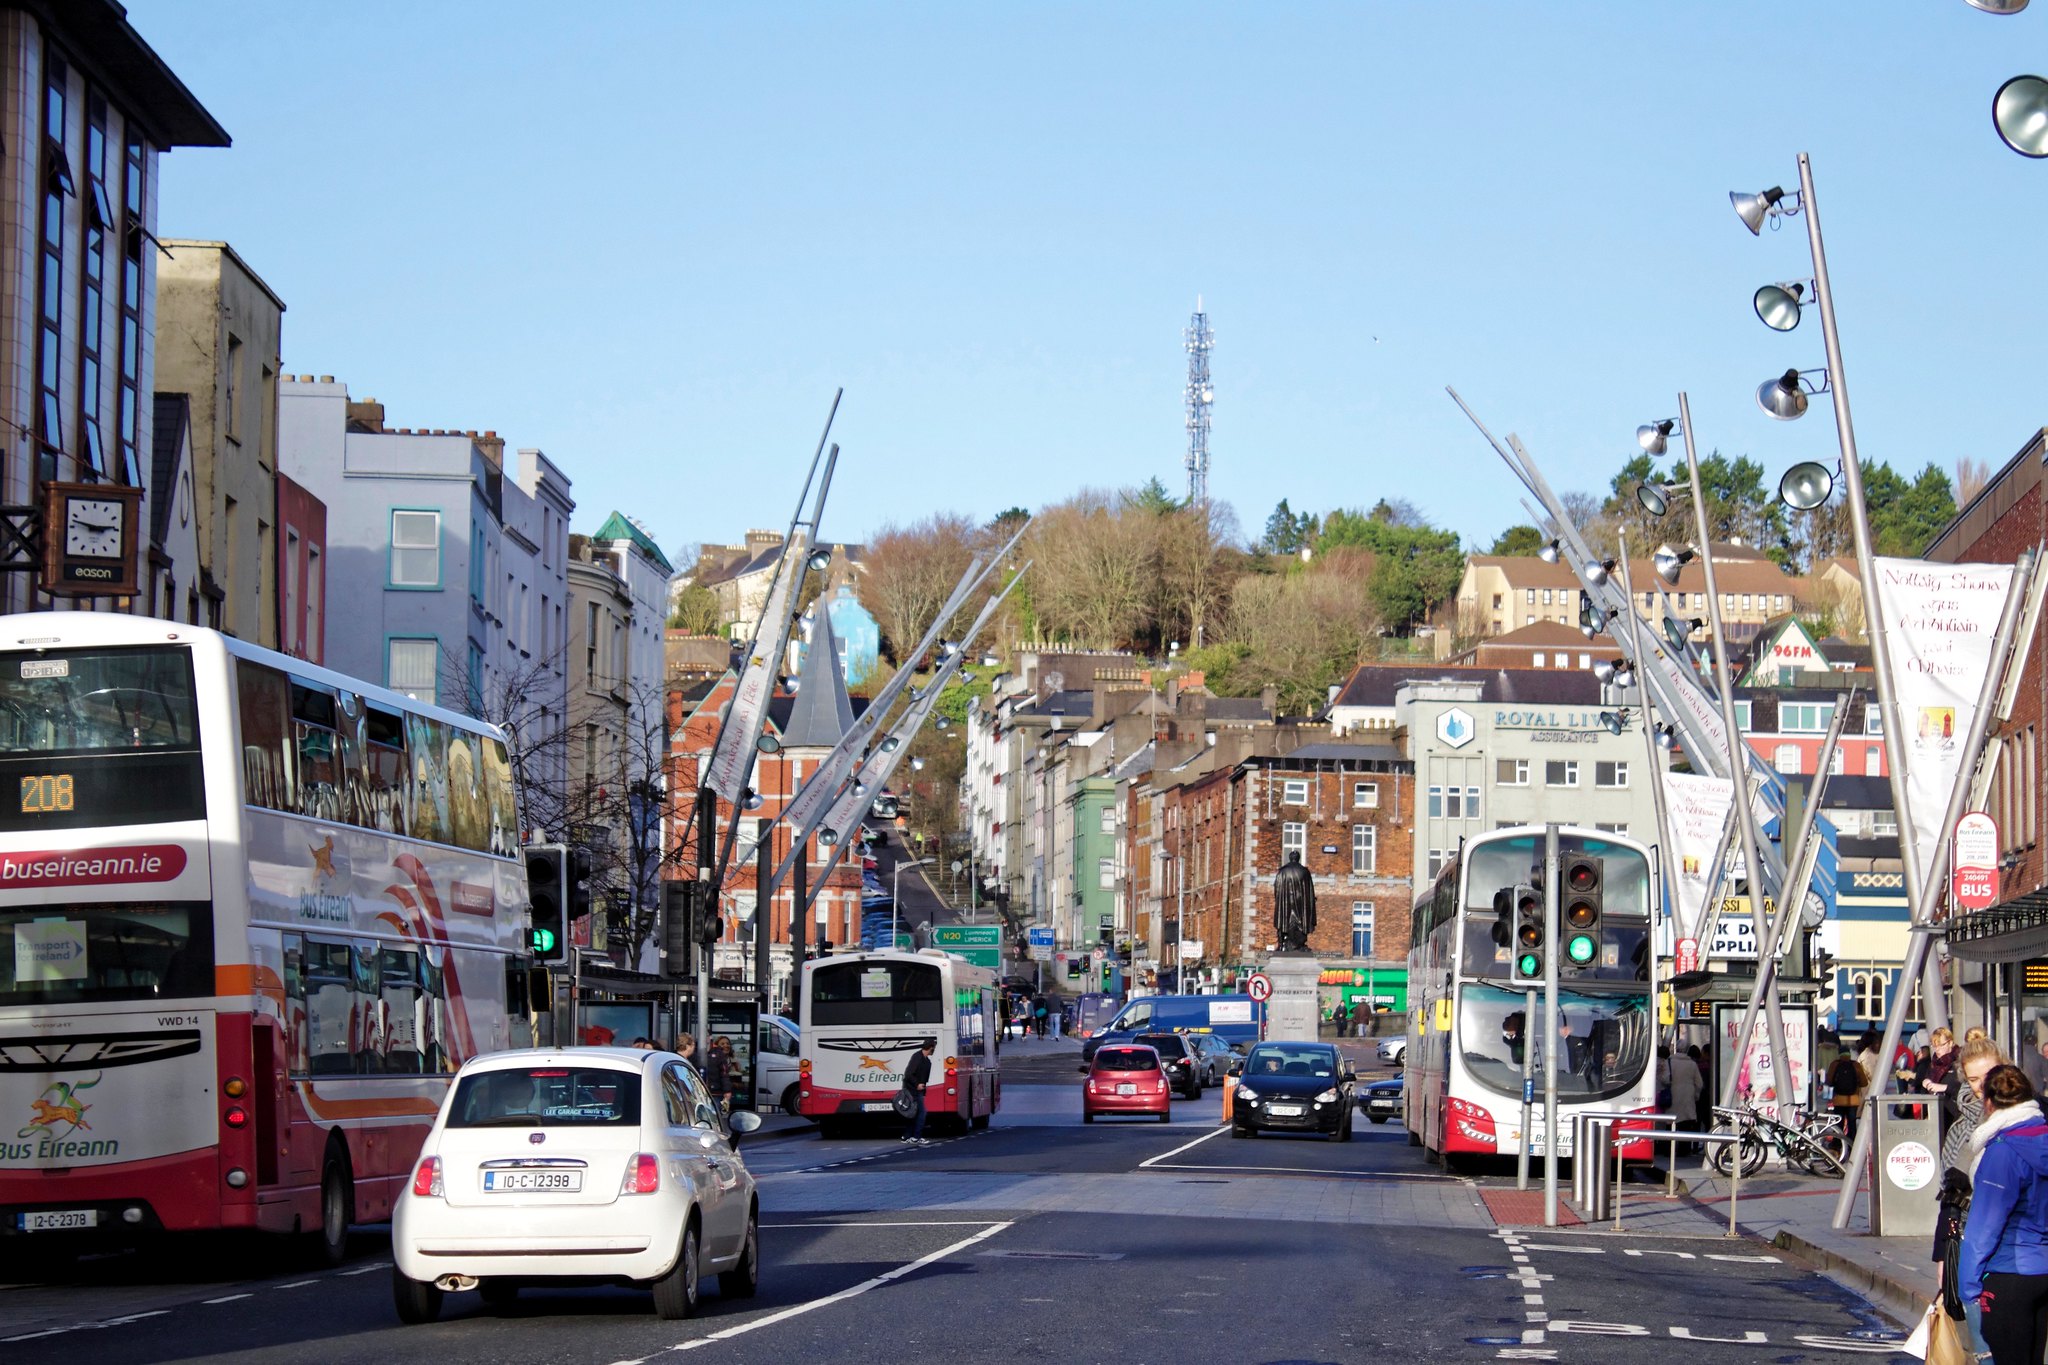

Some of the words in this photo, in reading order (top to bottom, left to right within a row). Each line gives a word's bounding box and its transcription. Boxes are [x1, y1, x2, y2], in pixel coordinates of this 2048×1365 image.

[75, 567, 112, 578] eason
[1885, 569, 1941, 592] Nollaig
[1951, 574, 2002, 591] Shona
[1495, 711, 1559, 727] ROYAL
[1530, 731, 1599, 744] ASSURANCE
[22, 774, 74, 812] 208
[1961, 884, 1992, 897] BUS
[943, 932, 961, 940] N20
[16, 941, 70, 951] Transport
[1318, 970, 1354, 984] agon
[158, 1017, 183, 1026] VWD
[187, 1016, 198, 1025] 14
[844, 1073, 865, 1083] Bus
[38, 1137, 119, 1159] Éireann
[503, 1175, 570, 1188] 10-C-12398
[35, 1214, 86, 1228] 12-C-2378
